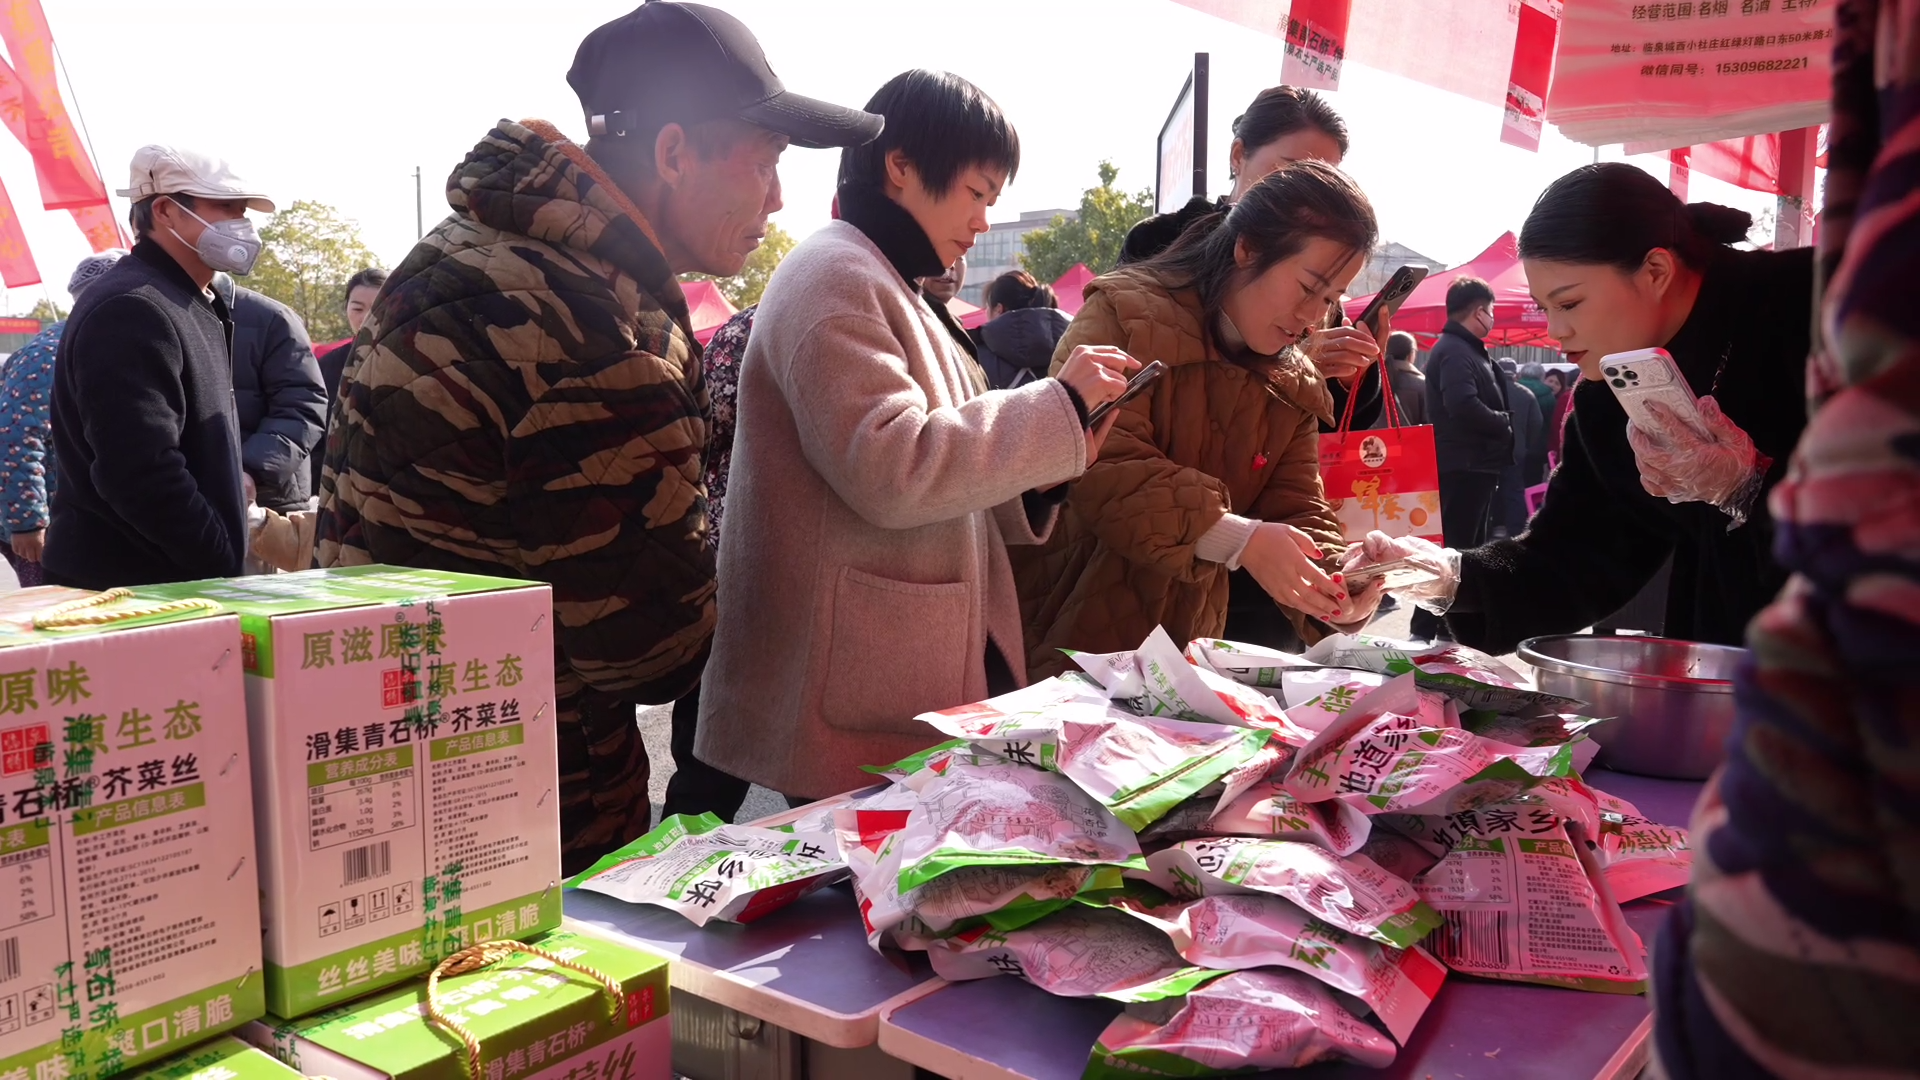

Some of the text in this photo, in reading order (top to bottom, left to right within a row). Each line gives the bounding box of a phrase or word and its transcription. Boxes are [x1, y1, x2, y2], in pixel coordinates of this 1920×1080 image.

[1715, 57, 1808, 74] 15309682221
[446, 729, 511, 756] 产品信息表
[325, 752, 398, 779] 营养成分表
[95, 791, 187, 828] 产品信息表
